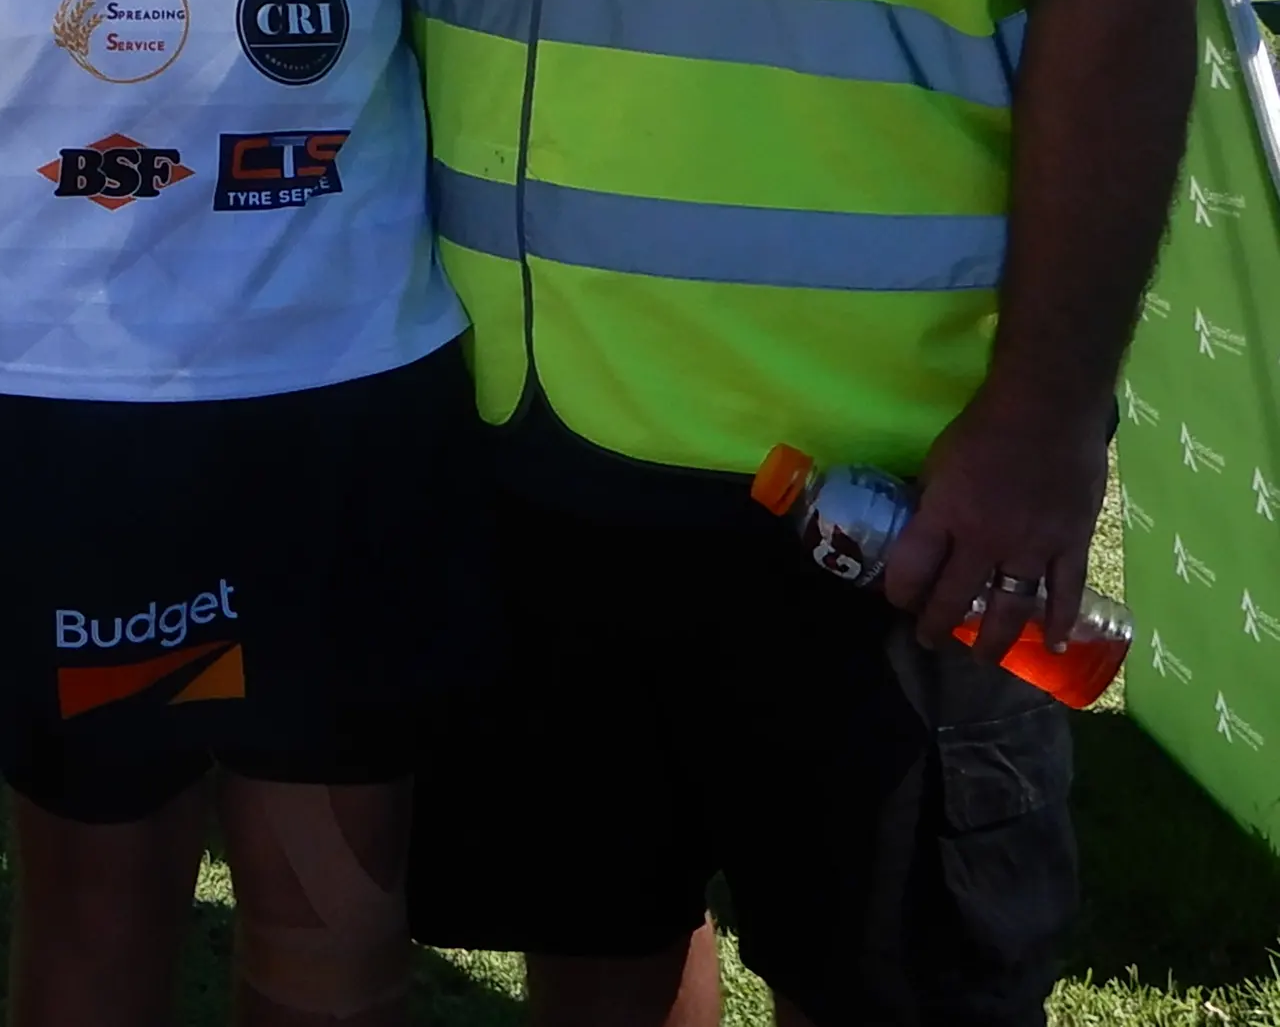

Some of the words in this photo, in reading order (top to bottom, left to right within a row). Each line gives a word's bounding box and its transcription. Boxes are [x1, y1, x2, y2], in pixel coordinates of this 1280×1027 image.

[257, 3, 333, 35] CRI
[54, 148, 180, 199] BSF
[227, 191, 272, 206] TYRE
[55, 578, 238, 648] Budget
